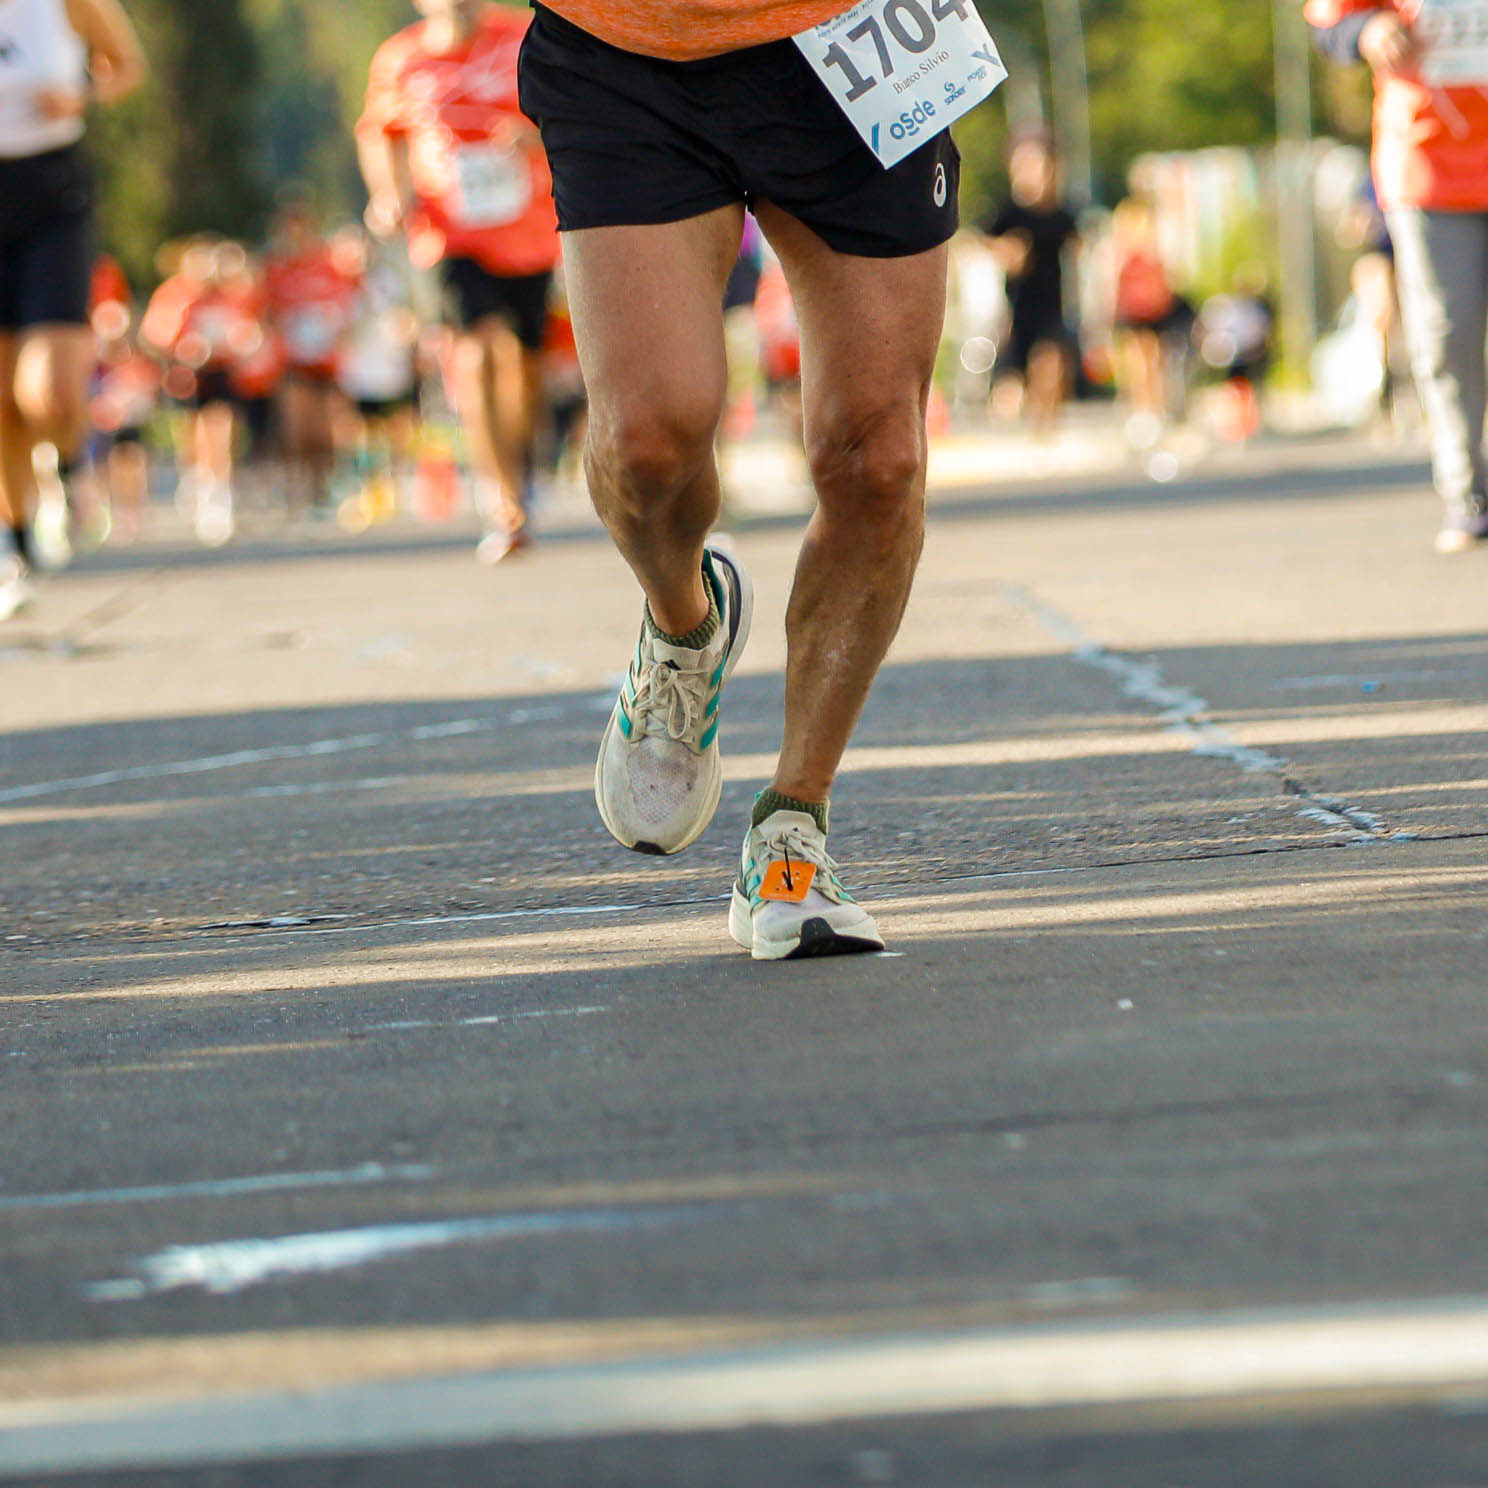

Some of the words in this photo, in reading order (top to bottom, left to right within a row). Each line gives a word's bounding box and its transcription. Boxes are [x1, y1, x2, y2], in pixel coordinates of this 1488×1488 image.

[892, 71, 921, 95] Bianco
[919, 50, 950, 74] Silvio
[889, 99, 937, 140] osde
